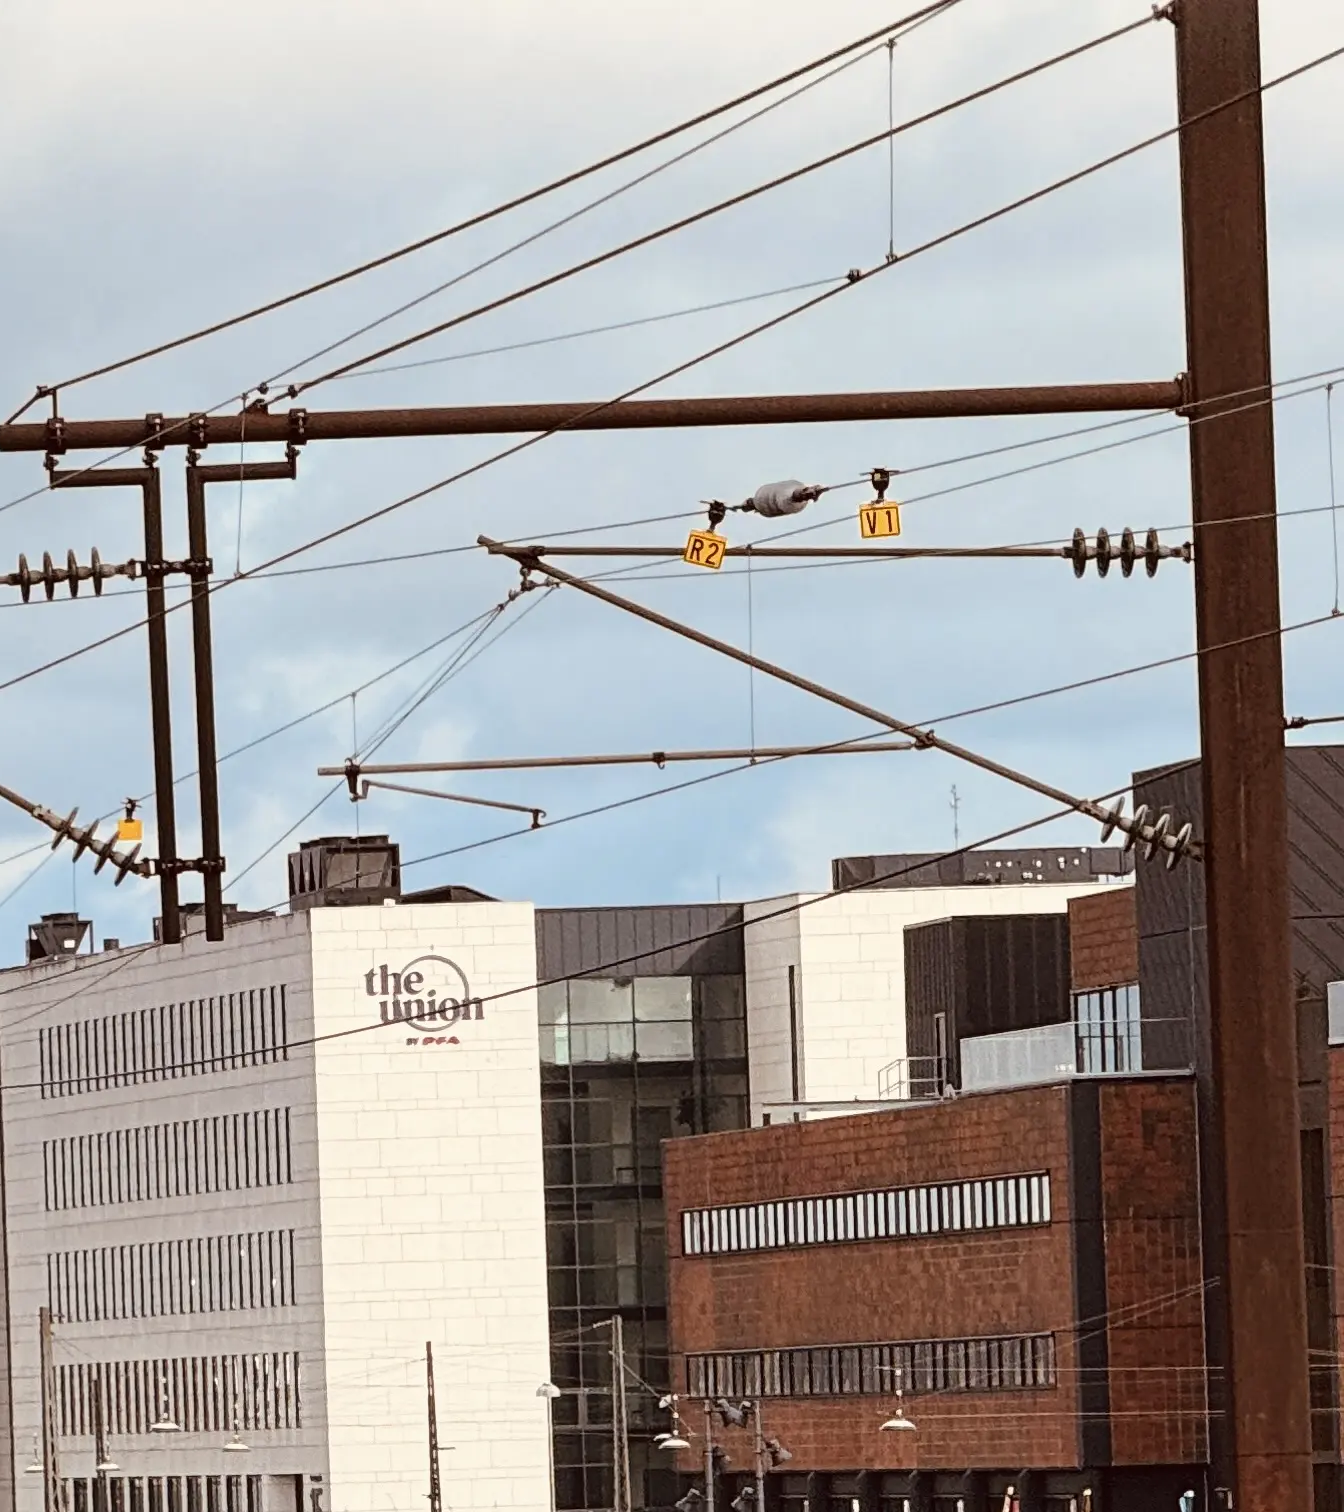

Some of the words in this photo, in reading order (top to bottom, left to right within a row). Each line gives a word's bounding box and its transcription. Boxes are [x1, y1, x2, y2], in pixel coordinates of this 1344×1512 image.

[865, 511, 893, 534] V1
[689, 539, 719, 566] R2
[364, 964, 424, 996] the
[379, 989, 485, 1024] union
[422, 1036, 460, 1046] PFA
